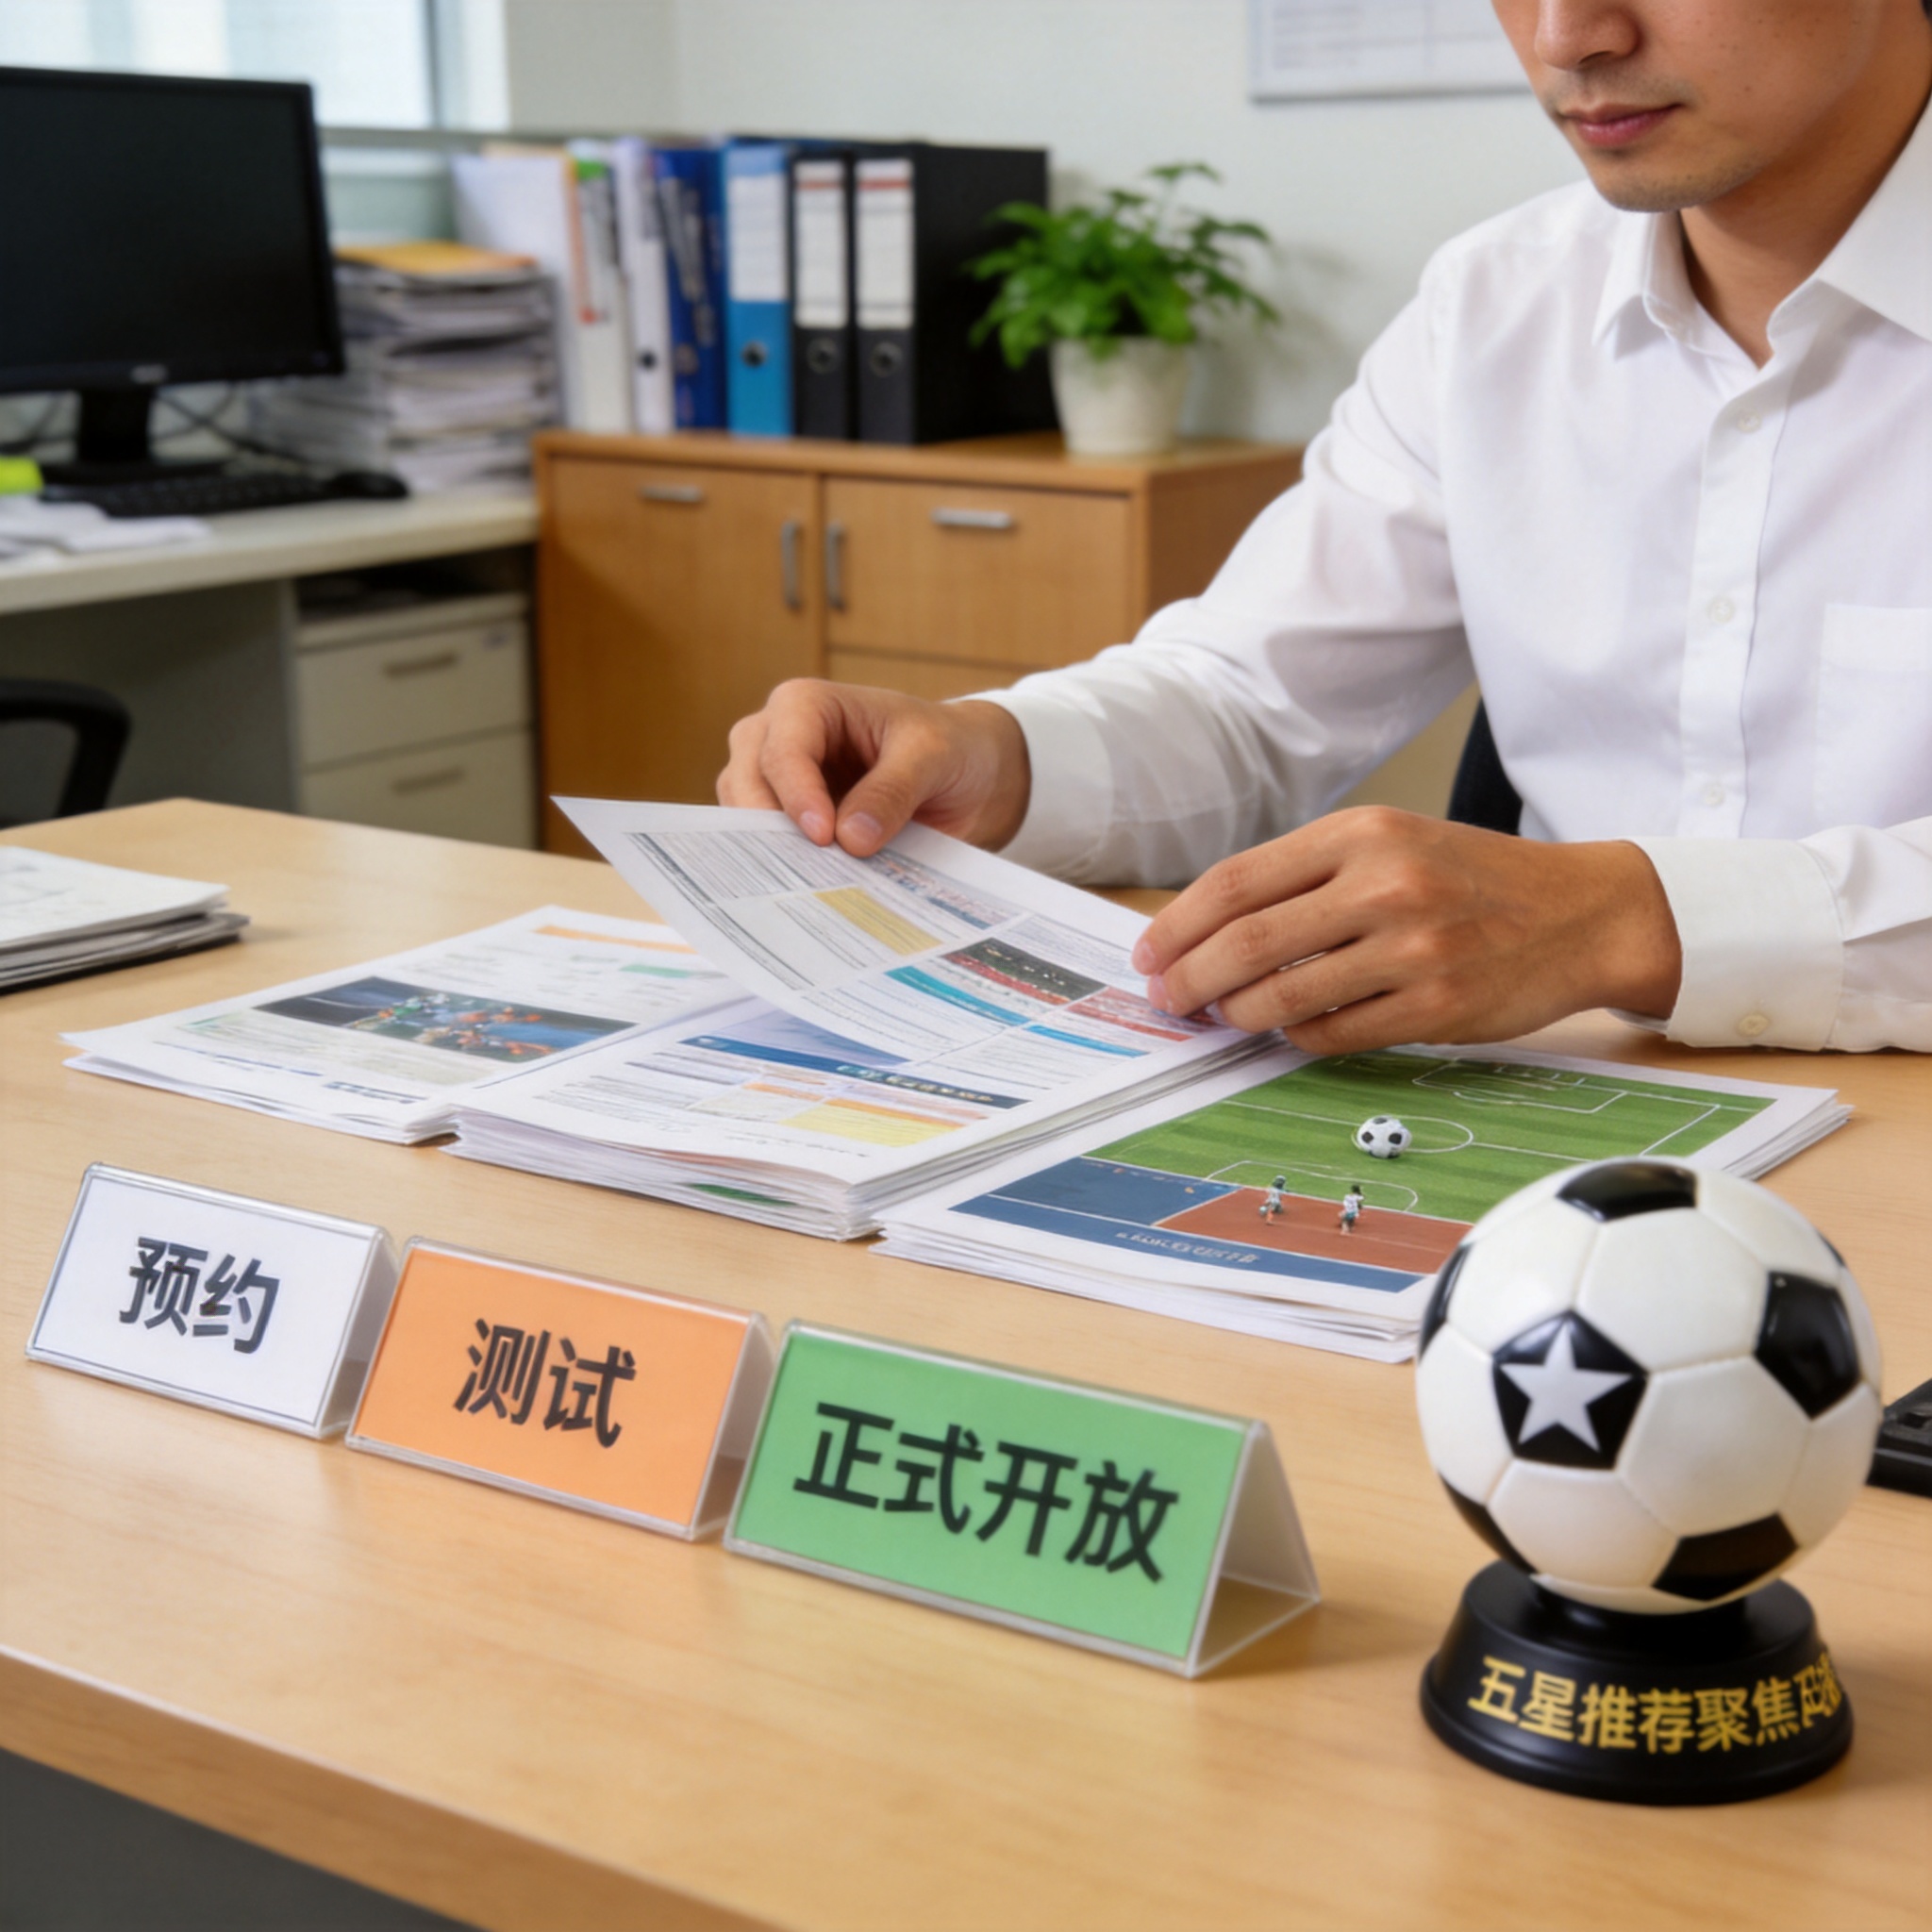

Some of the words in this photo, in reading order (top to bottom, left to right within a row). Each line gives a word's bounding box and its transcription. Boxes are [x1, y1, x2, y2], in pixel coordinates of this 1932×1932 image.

[119, 1237, 279, 1354] 预约
[454, 1319, 637, 1449] 测试
[792, 1402, 1179, 1584] 正式开放
